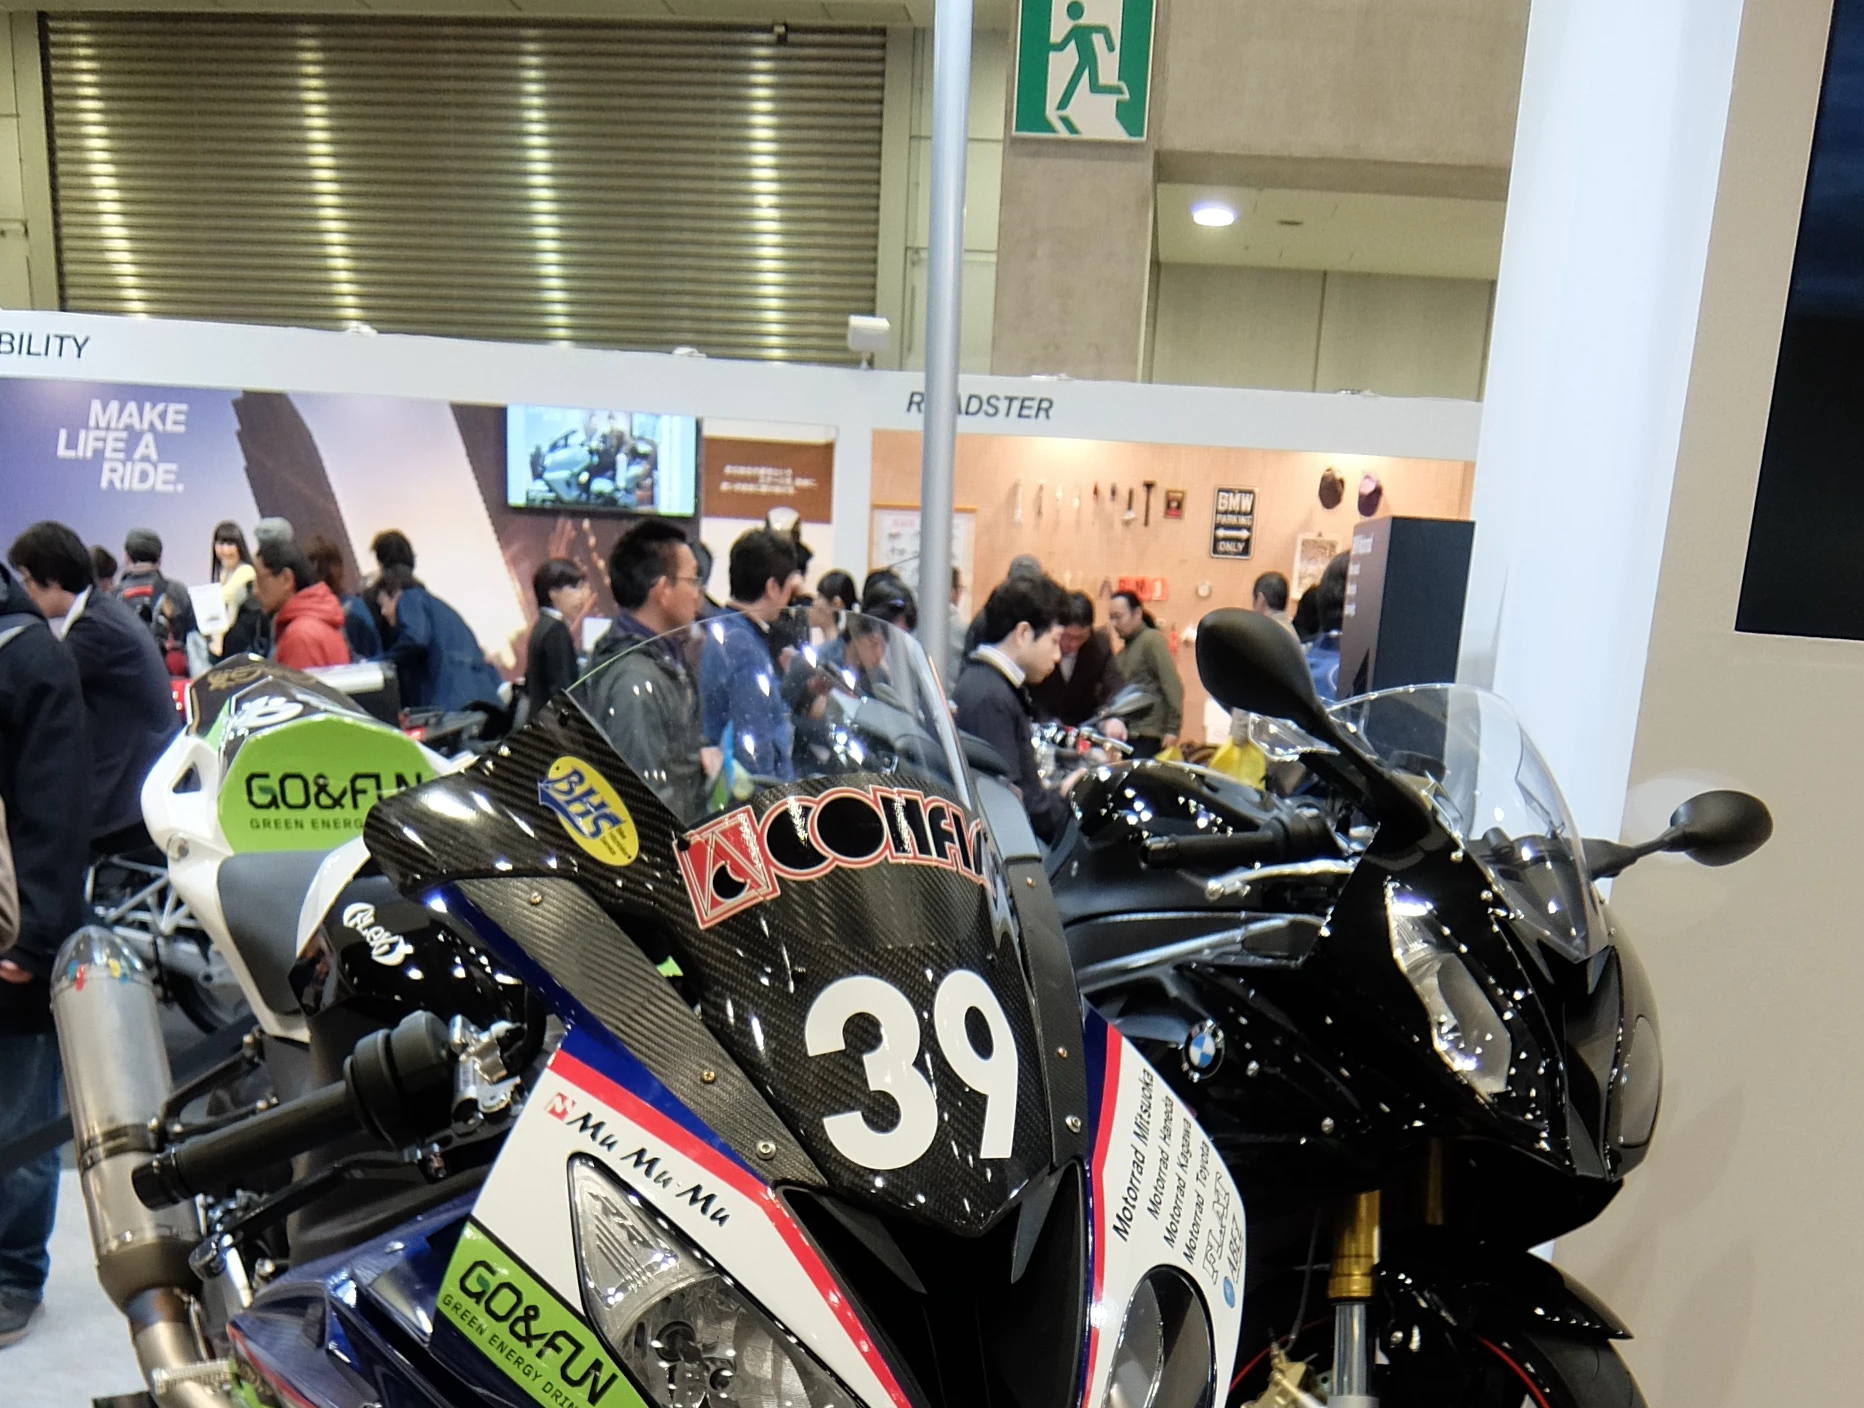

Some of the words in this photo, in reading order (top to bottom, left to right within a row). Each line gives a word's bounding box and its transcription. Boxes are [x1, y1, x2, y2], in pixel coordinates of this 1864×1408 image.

[88, 399, 189, 433] MAKE
[906, 391, 1054, 420] RDSTER
[57, 428, 128, 460] LIFE
[132, 431, 159, 462] A
[100, 460, 185, 493] RIDE.
[1216, 514, 1253, 527] PARKING
[1217, 491, 1254, 513] BMW
[1217, 541, 1245, 553] ONLY
[249, 817, 304, 831] GREEN
[538, 764, 627, 840] BHS
[804, 969, 1018, 1170] 39
[566, 1112, 619, 1152] Mu
[620, 1147, 673, 1189] Mu
[675, 1184, 730, 1228] Mu
[1112, 1144, 1146, 1243] Motorrad
[1133, 1068, 1154, 1148] Mitsuoka
[1147, 1145, 1170, 1220] Motorrad
[1161, 1095, 1174, 1148] Haneda
[1163, 1173, 1187, 1250] Motorrad
[1177, 1117, 1194, 1175] Kagawa
[1183, 1192, 1206, 1266] Motorrad
[1196, 1140, 1213, 1192] Toyota
[442, 1293, 488, 1337] GREEN
[488, 1334, 543, 1382] ENERGY
[459, 1260, 619, 1406] GO&FUN
